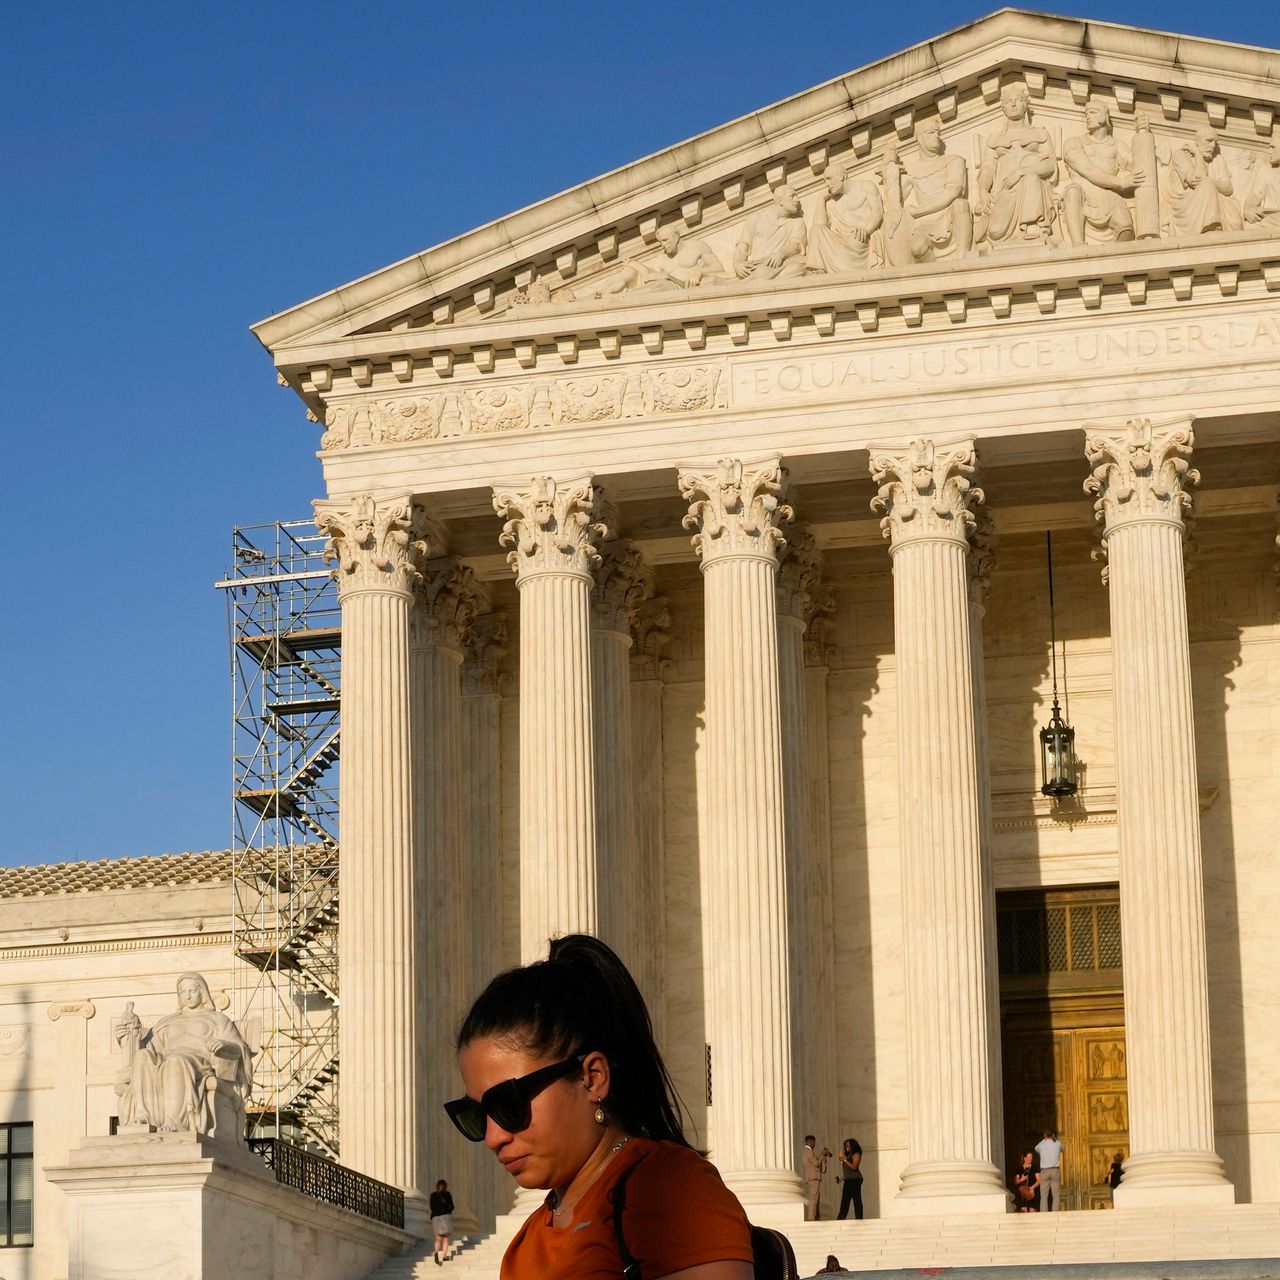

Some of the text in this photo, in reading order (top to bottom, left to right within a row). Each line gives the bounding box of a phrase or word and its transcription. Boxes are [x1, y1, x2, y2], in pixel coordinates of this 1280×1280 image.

[753, 356, 885, 395] EQUAL
[896, 339, 1055, 381] JUSTICE
[1074, 324, 1219, 362] UNDER
